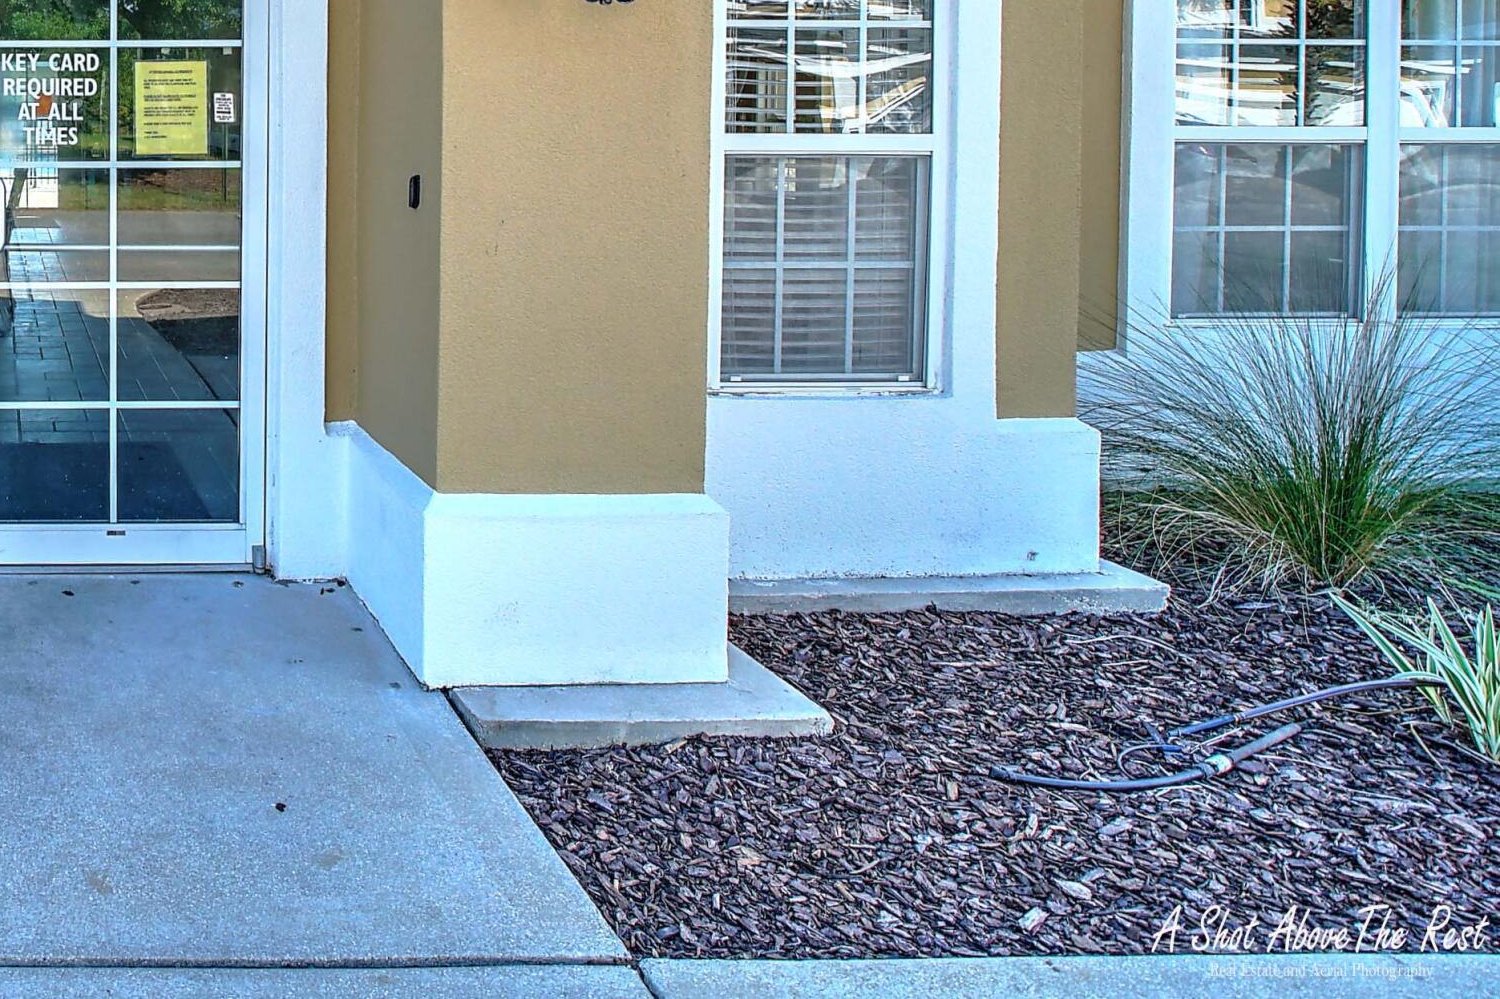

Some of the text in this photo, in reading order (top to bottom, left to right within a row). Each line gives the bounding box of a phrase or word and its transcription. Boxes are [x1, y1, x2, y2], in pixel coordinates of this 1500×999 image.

[1, 53, 100, 72] KEY CARD
[3, 77, 98, 100] REQUIRED
[18, 102, 84, 121] AT ALL
[23, 126, 79, 146] TIMES
